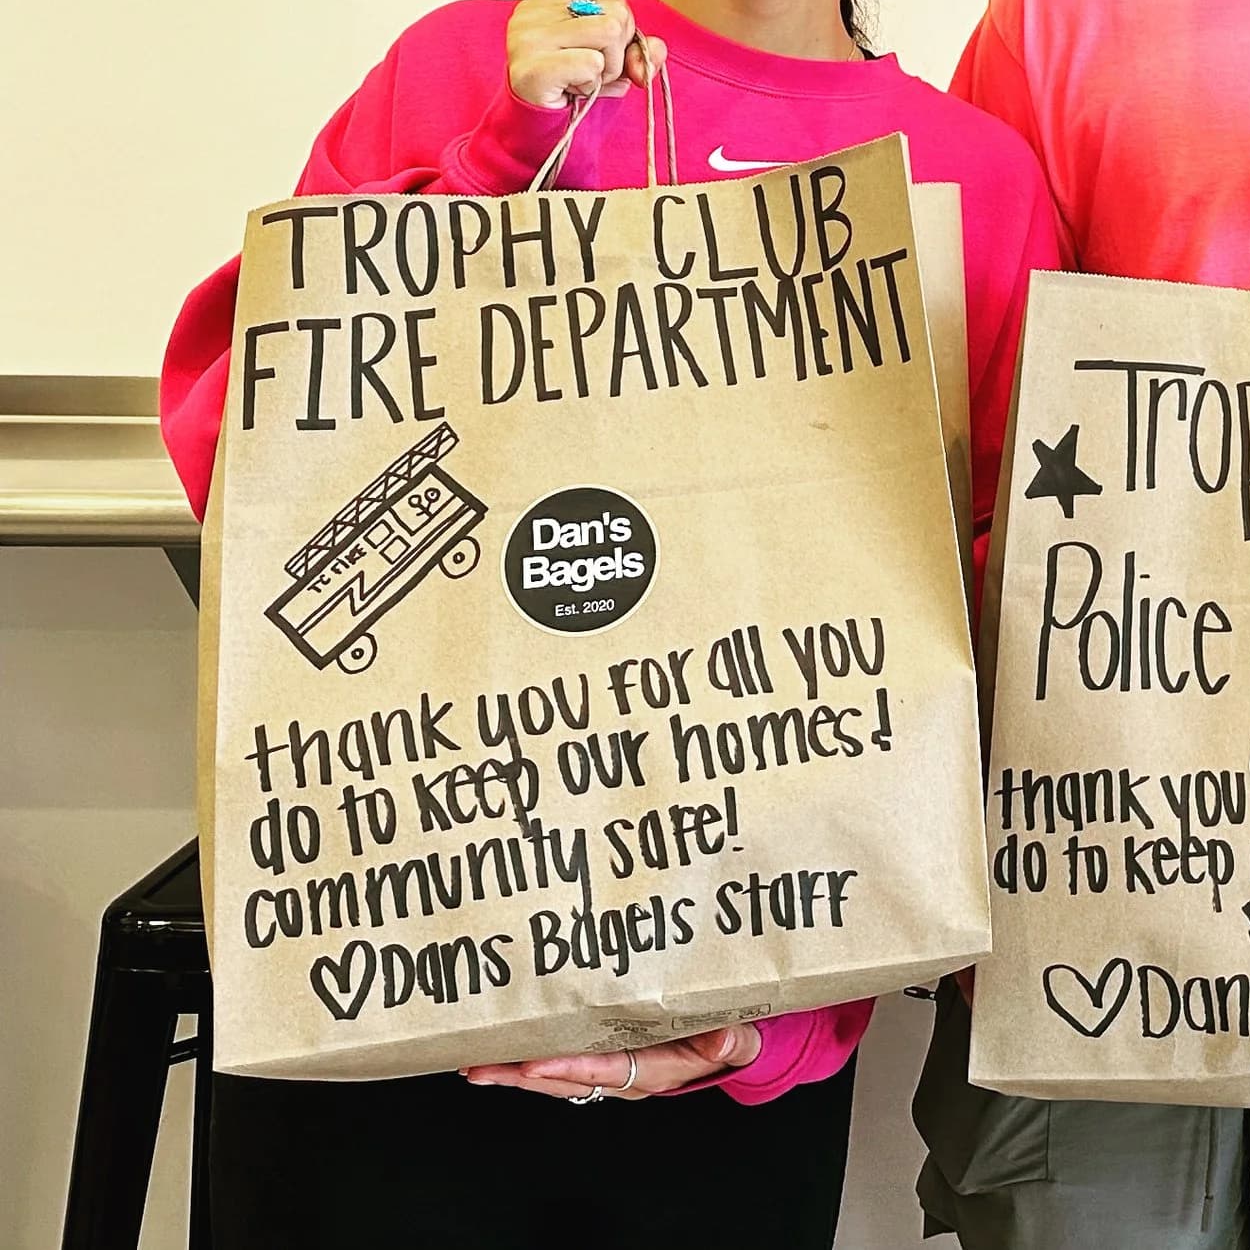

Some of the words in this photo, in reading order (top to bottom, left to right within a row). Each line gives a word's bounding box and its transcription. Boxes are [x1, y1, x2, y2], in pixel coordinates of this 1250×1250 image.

[263, 196, 606, 297] TROPHY
[653, 166, 853, 282] CLUB
[242, 308, 446, 431] FIRE
[481, 249, 912, 405] DEPARTMENT
[307, 573, 332, 593] TC
[331, 542, 367, 574] FIRE
[522, 547, 645, 592] Bagels
[532, 512, 632, 550] Dan's
[555, 603, 580, 617] Est.
[582, 598, 615, 615] 2020
[1035, 541, 1233, 701] Police
[245, 692, 459, 792] thank
[477, 672, 590, 760] you
[706, 624, 774, 699] all
[783, 617, 886, 701] you
[249, 797, 322, 877] do
[337, 784, 396, 857] to
[557, 726, 648, 795] our
[671, 688, 893, 784] homes!
[994, 767, 1155, 833] thank
[1160, 771, 1246, 845] you
[244, 818, 594, 950] community
[993, 834, 1048, 895] do
[1062, 835, 1109, 896] to
[382, 931, 516, 1010] Dans
[528, 894, 695, 978] Bagels
